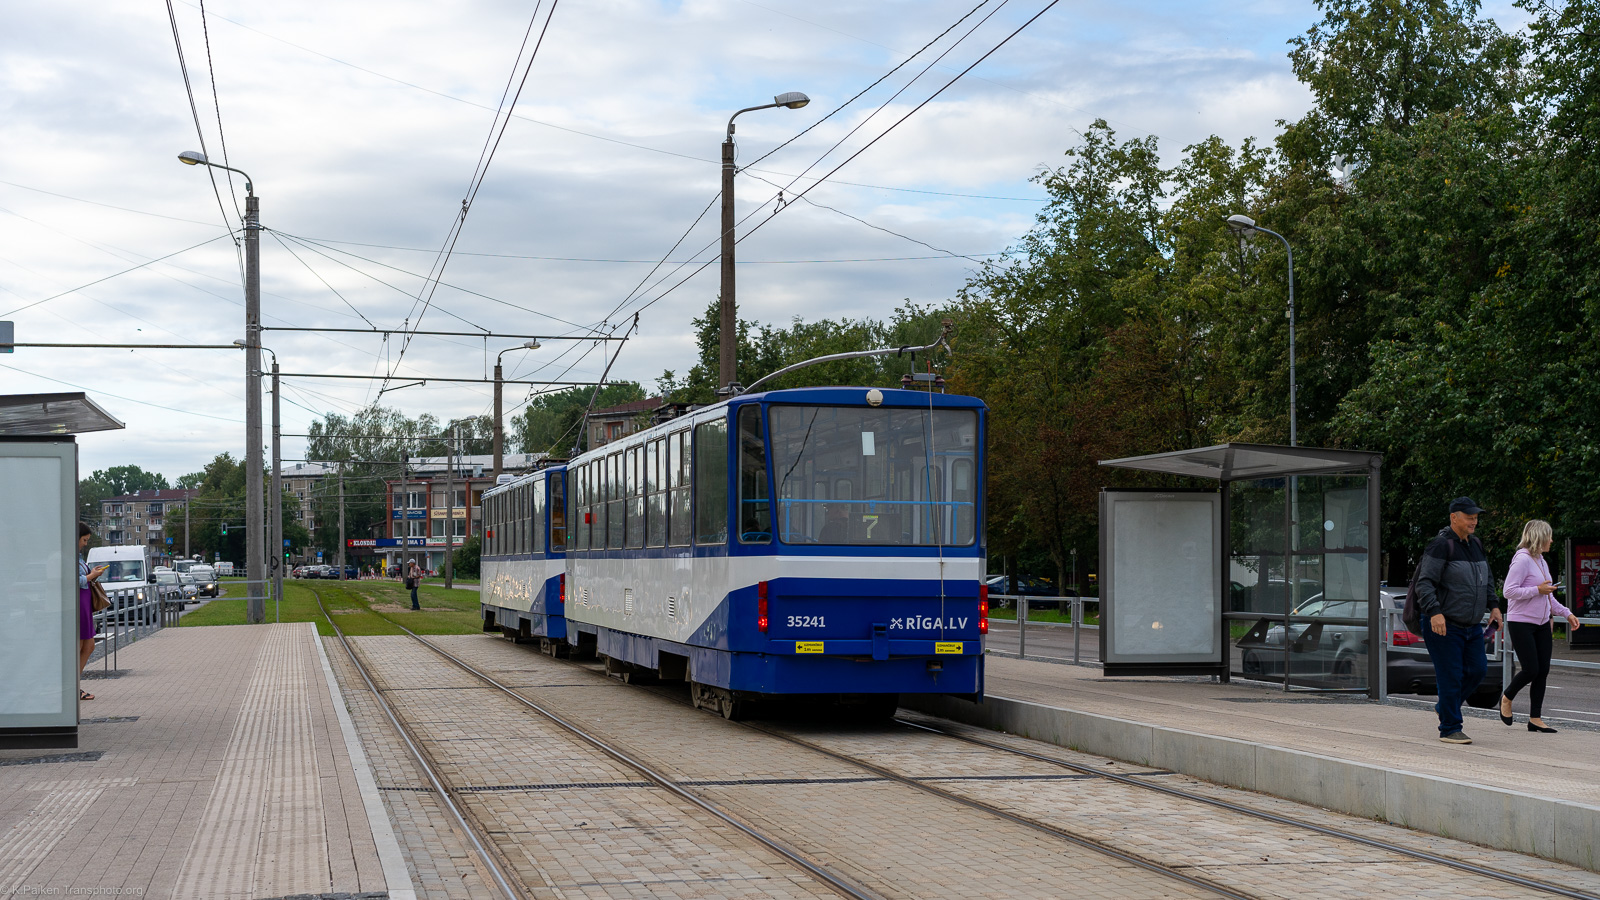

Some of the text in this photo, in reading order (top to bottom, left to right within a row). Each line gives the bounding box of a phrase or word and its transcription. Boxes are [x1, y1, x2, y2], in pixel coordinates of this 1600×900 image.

[862, 515, 879, 539] 7
[786, 615, 826, 628] 35241
[906, 615, 968, 630] RĪGA.LV
